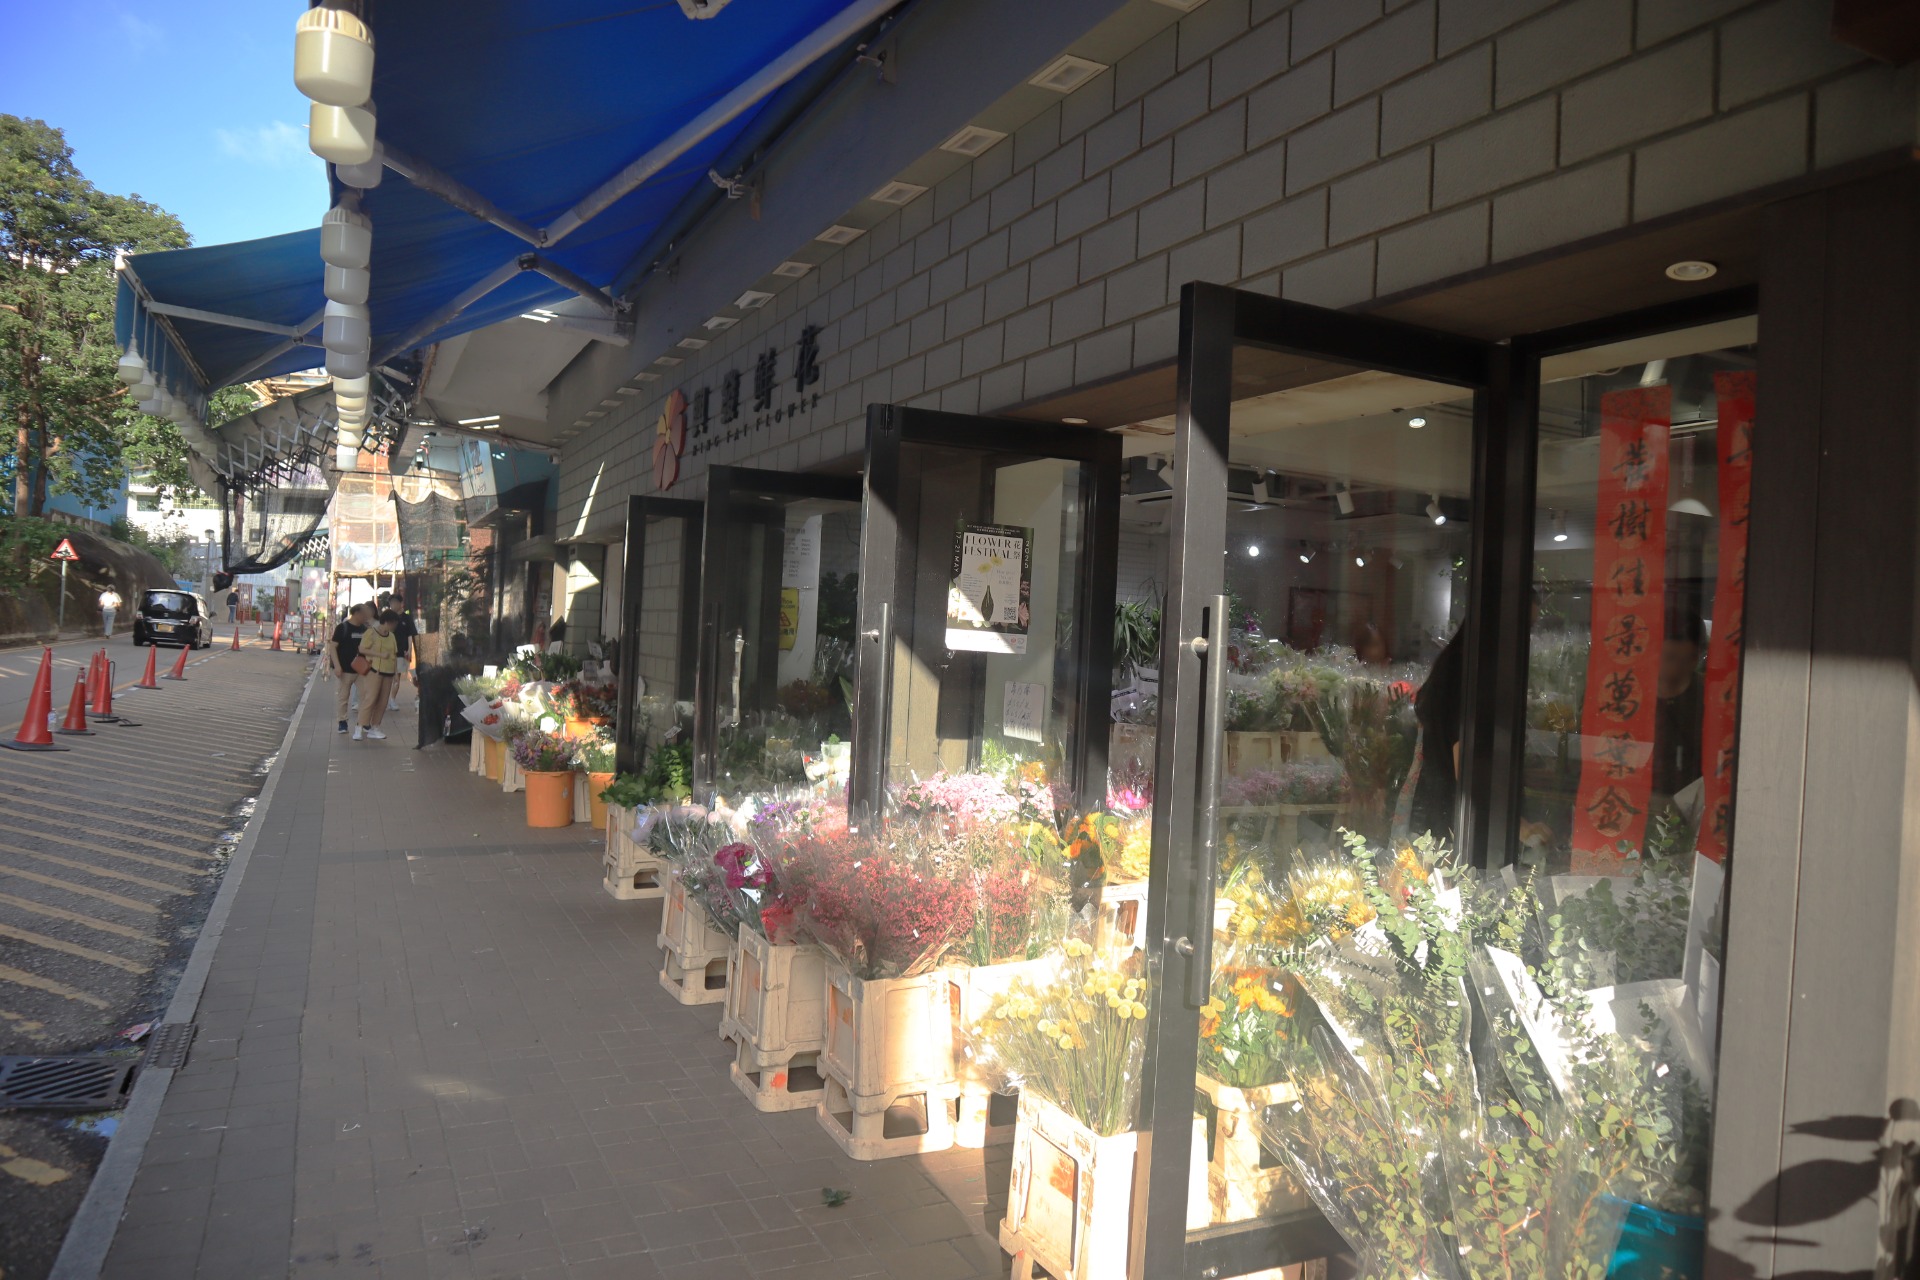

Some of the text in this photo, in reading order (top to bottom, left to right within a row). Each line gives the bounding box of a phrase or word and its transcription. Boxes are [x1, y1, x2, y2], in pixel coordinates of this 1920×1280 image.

[756, 392, 819, 432] FLOWER
[965, 535, 1011, 549] FLOWER
[963, 545, 1013, 560] FESTIVAL
